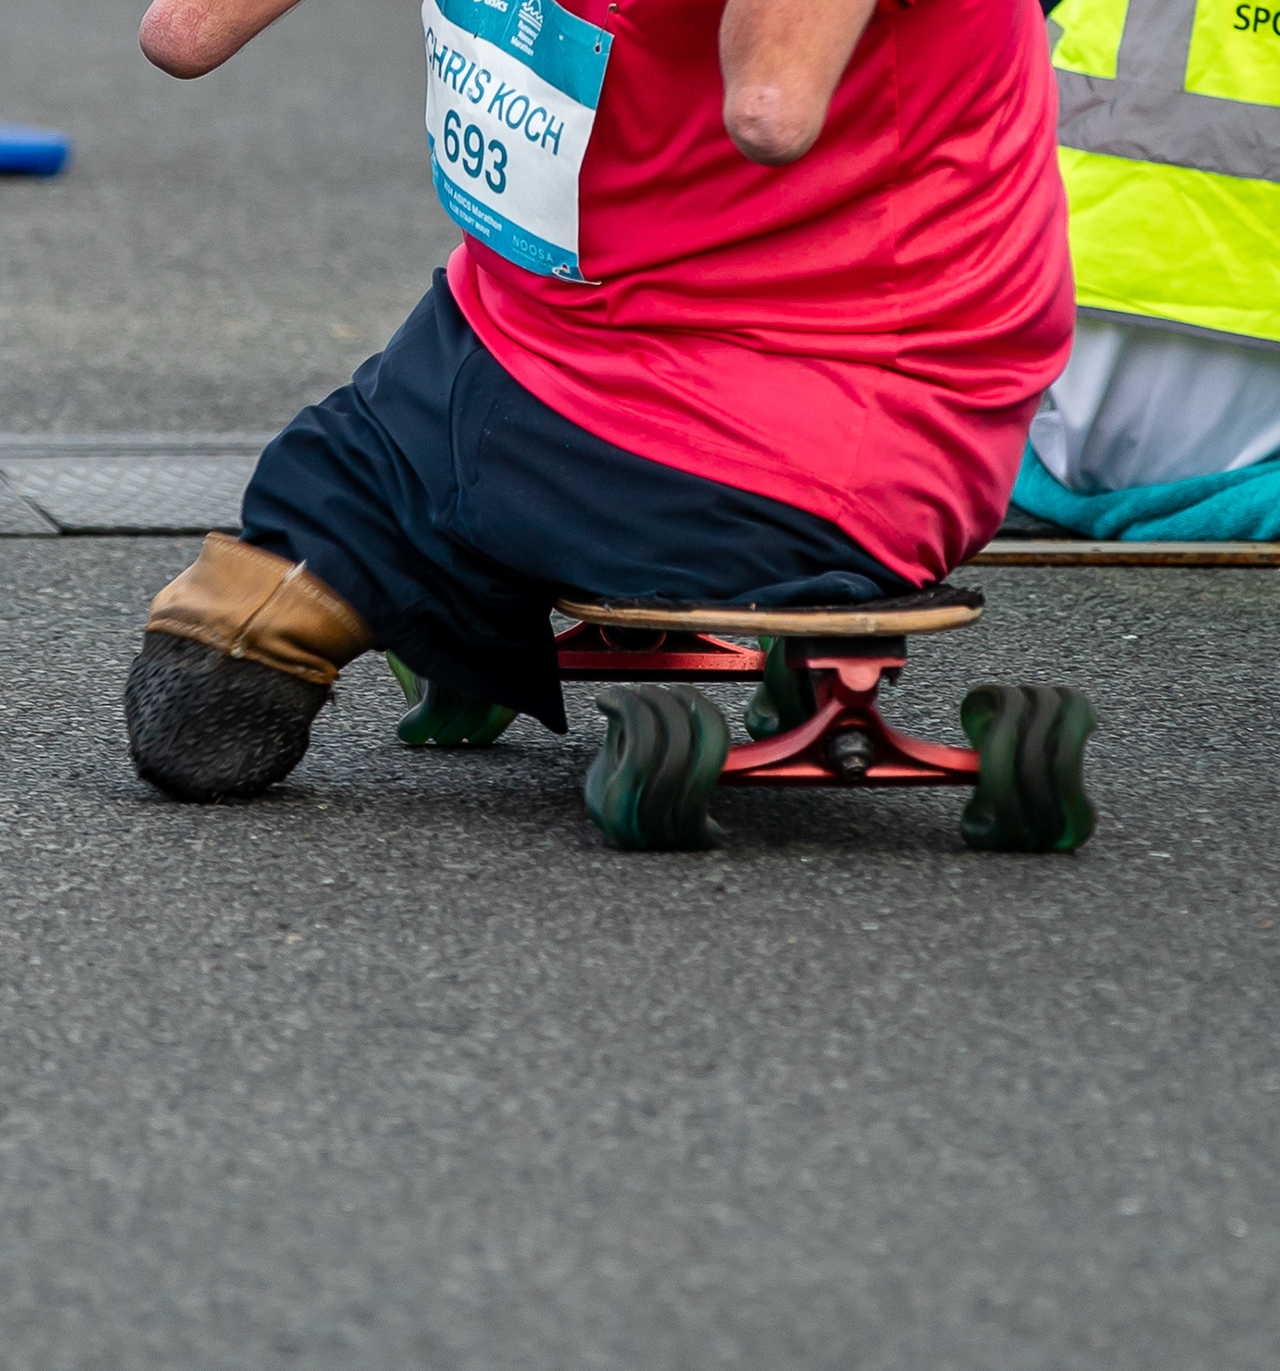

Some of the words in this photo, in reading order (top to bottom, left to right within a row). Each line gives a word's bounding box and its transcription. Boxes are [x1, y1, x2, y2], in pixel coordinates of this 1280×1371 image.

[425, 26, 492, 104] CHRIS
[487, 81, 564, 156] KOCH
[443, 109, 508, 194] 693
[512, 235, 555, 264] NOOSA
